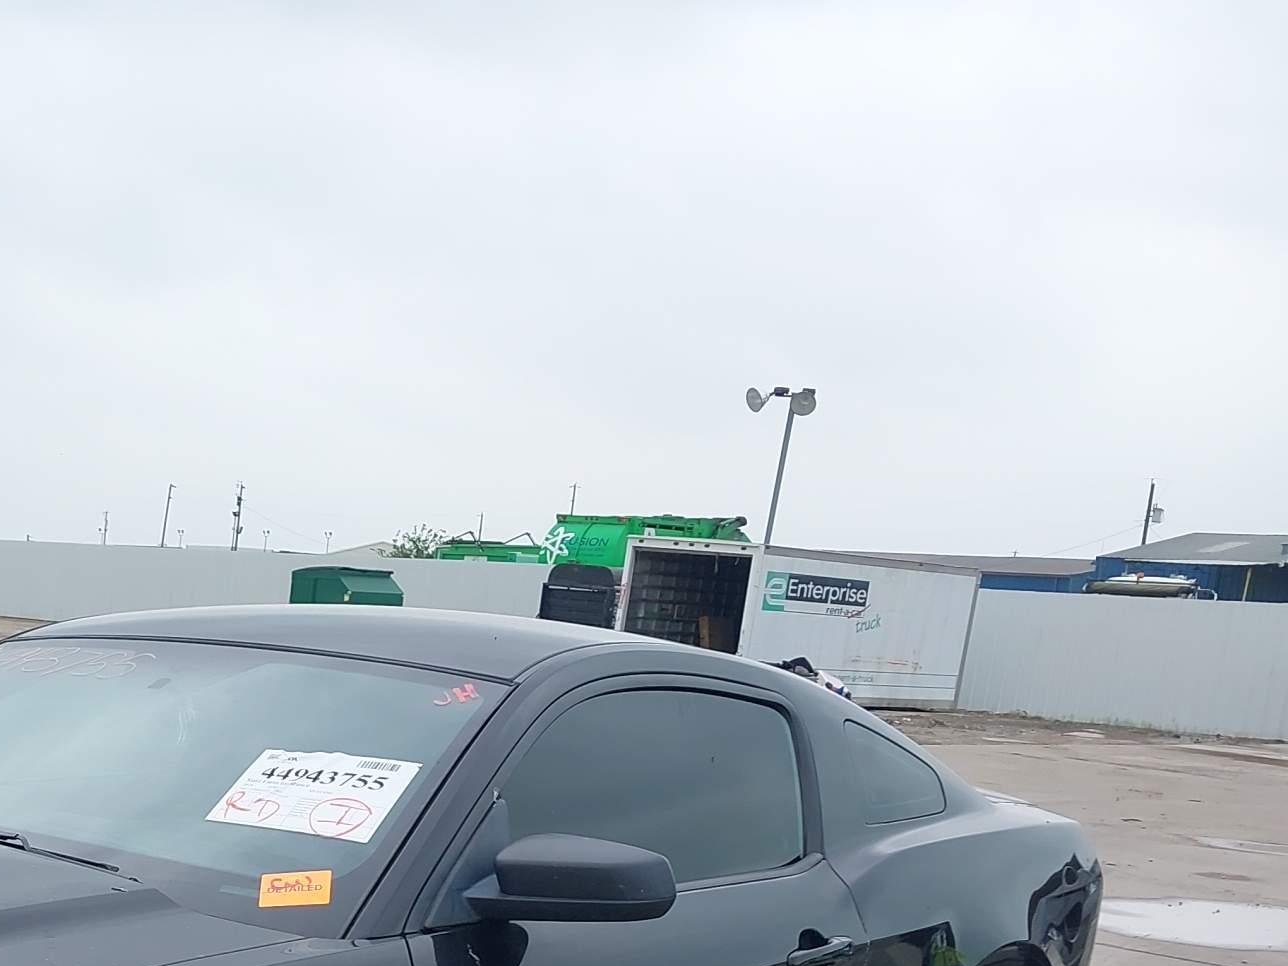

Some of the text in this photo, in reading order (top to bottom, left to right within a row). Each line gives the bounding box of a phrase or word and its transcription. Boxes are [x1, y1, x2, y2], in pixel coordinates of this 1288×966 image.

[787, 579, 867, 604] Enterprise
[855, 613, 881, 633] truck
[261, 766, 389, 791] 44943755
